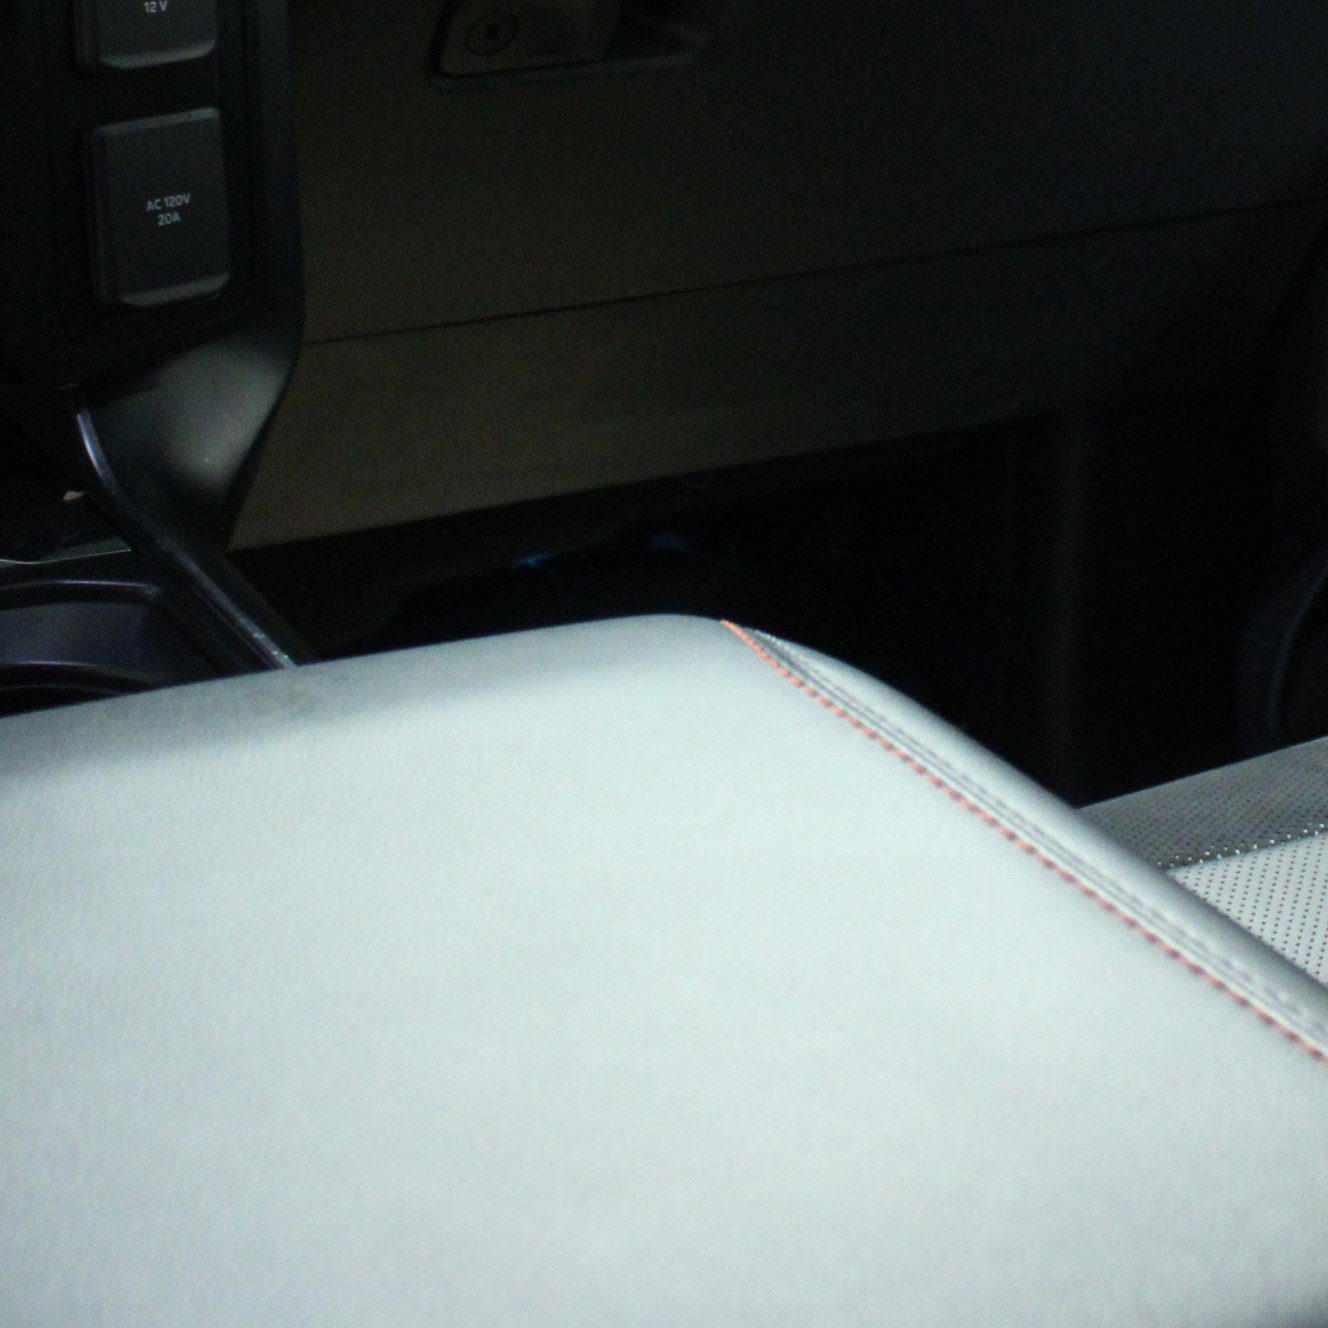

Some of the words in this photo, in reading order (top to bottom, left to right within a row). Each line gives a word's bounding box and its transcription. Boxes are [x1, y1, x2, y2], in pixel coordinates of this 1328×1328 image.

[144, 1, 157, 13] 12
[146, 198, 162, 212] AC
[163, 193, 191, 207] 120V
[158, 211, 181, 226] 20A
